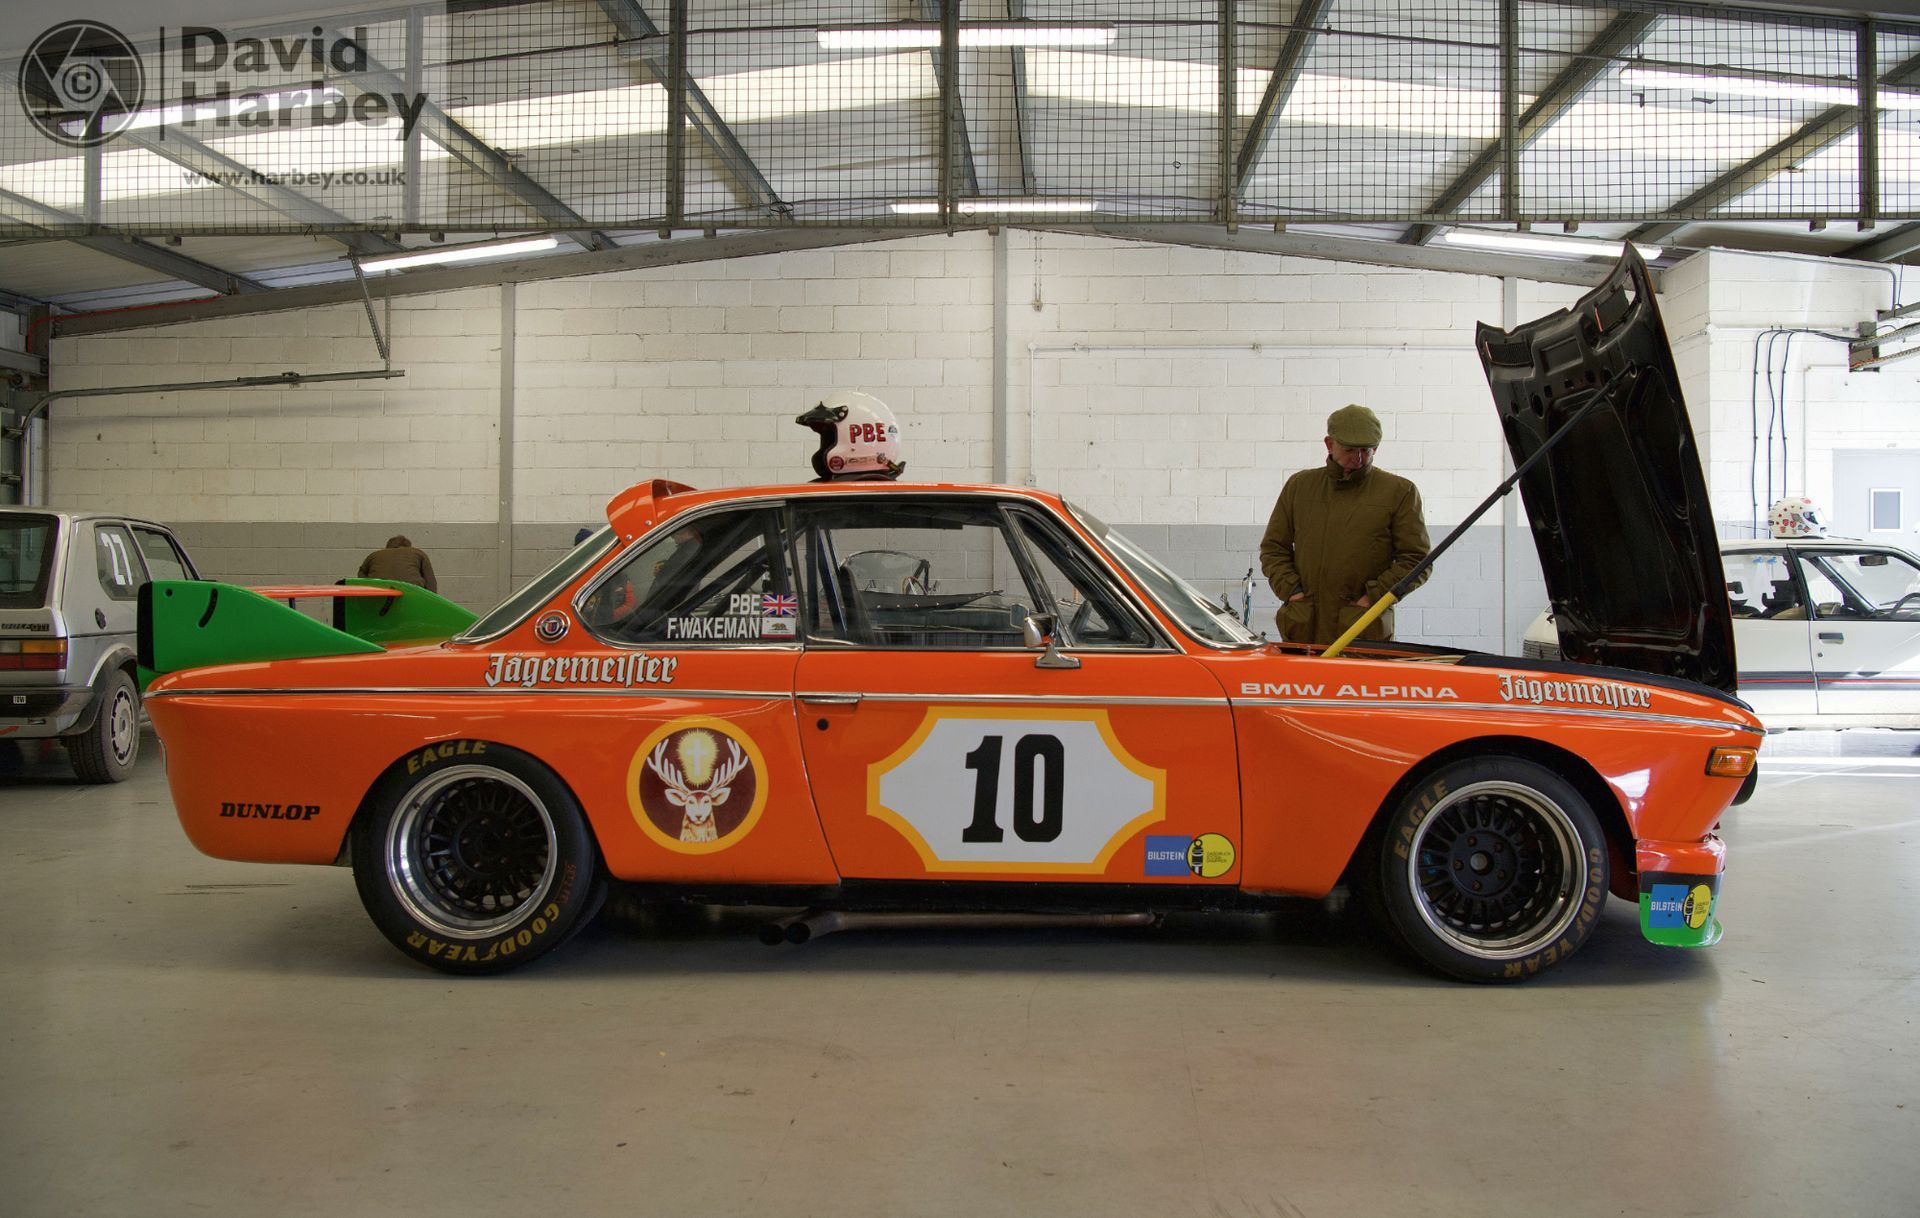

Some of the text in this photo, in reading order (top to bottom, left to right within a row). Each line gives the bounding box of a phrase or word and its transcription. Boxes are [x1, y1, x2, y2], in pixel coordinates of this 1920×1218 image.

[849, 422, 887, 444] PBE
[729, 594, 761, 615] PBE
[1240, 682, 1459, 699] BMW ALPINA
[406, 740, 488, 776] EAGLE
[962, 733, 1065, 843] 10
[219, 802, 321, 821] DUNLOP
[1394, 779, 1449, 861] EAGLE
[1147, 851, 1185, 861] BILSTEIN
[1650, 901, 1683, 912] BILSTEIN
